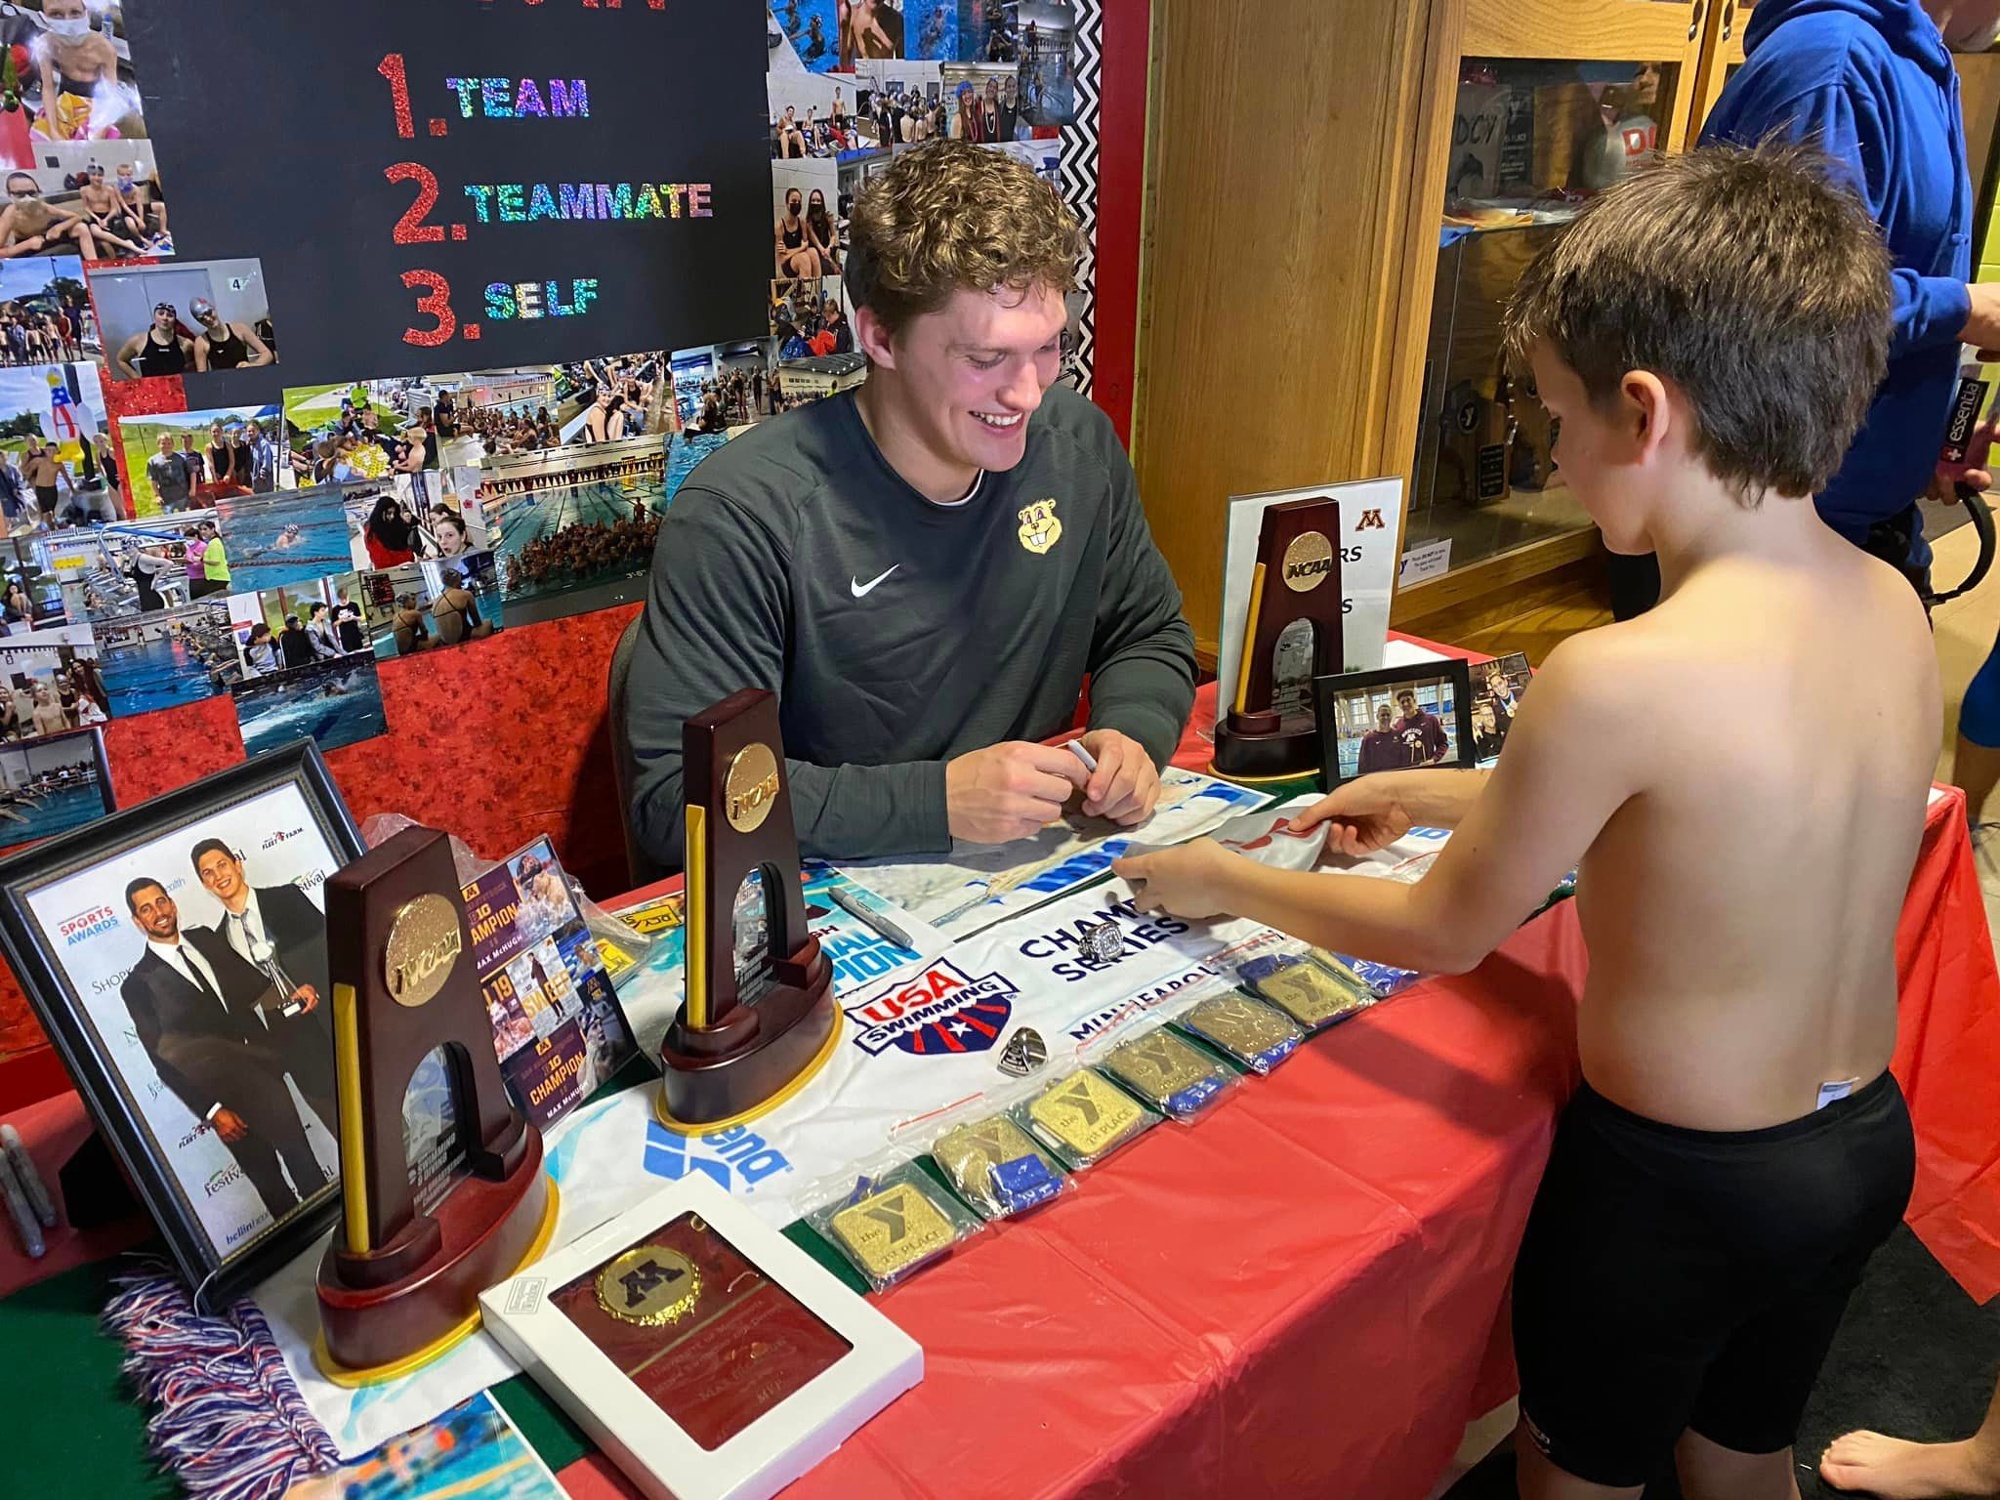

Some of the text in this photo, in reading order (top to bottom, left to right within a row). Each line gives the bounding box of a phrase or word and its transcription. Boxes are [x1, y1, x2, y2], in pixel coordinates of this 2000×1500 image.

[377, 53, 590, 138] 1. TEAM
[383, 162, 713, 245] 2. TEAMMATE
[400, 268, 598, 347] 3. SELF
[1950, 382, 1980, 442] essentia
[1286, 556, 1332, 580] NCAA
[60, 906, 113, 937] SPORTS
[67, 915, 119, 946] AWARDS
[470, 902, 520, 946] AMPION
[863, 970, 966, 1022] USA
[866, 981, 1001, 1042] SWIMMING
[700, 1123, 790, 1185] ena
[861, 1228, 882, 1244] the
[901, 1230, 941, 1255] PLACE
